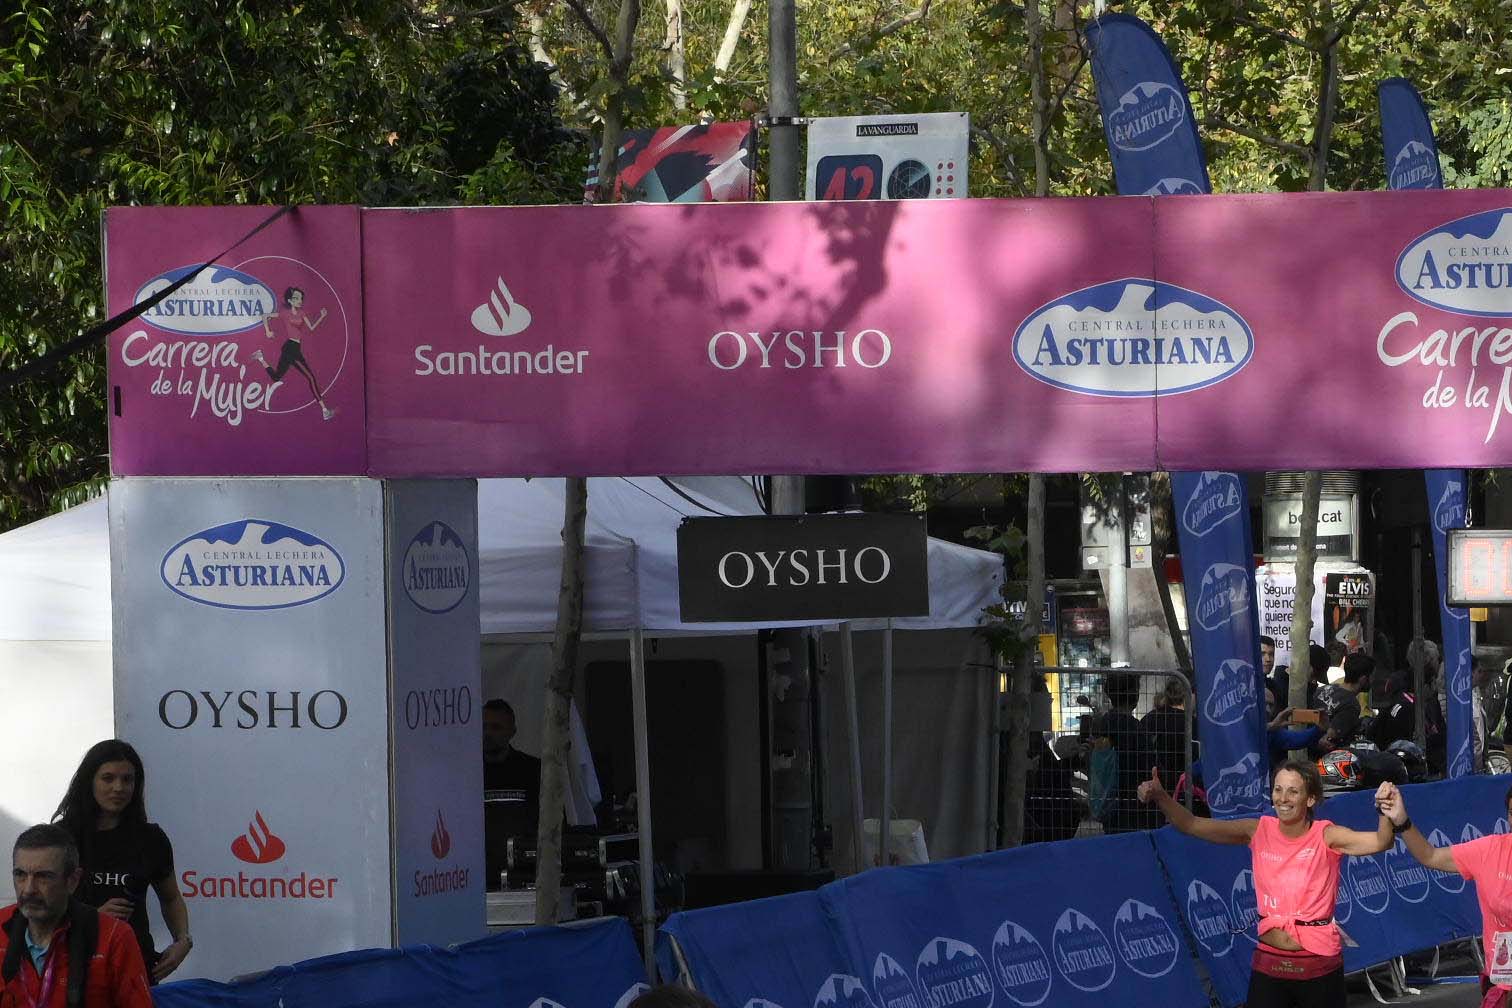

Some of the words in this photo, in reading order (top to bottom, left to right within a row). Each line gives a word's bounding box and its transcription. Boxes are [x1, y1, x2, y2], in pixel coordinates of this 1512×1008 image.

[144, 288, 266, 317] ASTURIANA
[214, 286, 261, 296] LECHERA
[1067, 319, 1144, 332] CENTRAL
[1151, 317, 1228, 331] LECHERA
[121, 331, 240, 369] Carrera
[414, 344, 589, 375] Santander
[707, 328, 892, 370] OYSHO
[1031, 322, 1234, 366] ASTURIANA
[151, 370, 173, 395] de
[176, 369, 194, 395] la
[192, 362, 283, 427] Mujer
[1422, 370, 1457, 409] de
[1464, 366, 1491, 409] la
[176, 553, 332, 588] ASTURIANA
[203, 551, 263, 560] CENTRAL
[267, 550, 325, 560] LECHERA
[719, 546, 892, 588] OYSHO
[407, 558, 466, 593] ASTURIANA
[1339, 582, 1369, 595] ELVIS
[1264, 599, 1281, 612] que
[158, 689, 348, 730] OYSHO
[405, 685, 472, 730] OYSHO
[182, 871, 338, 899] Santander
[414, 865, 470, 898] Santander
